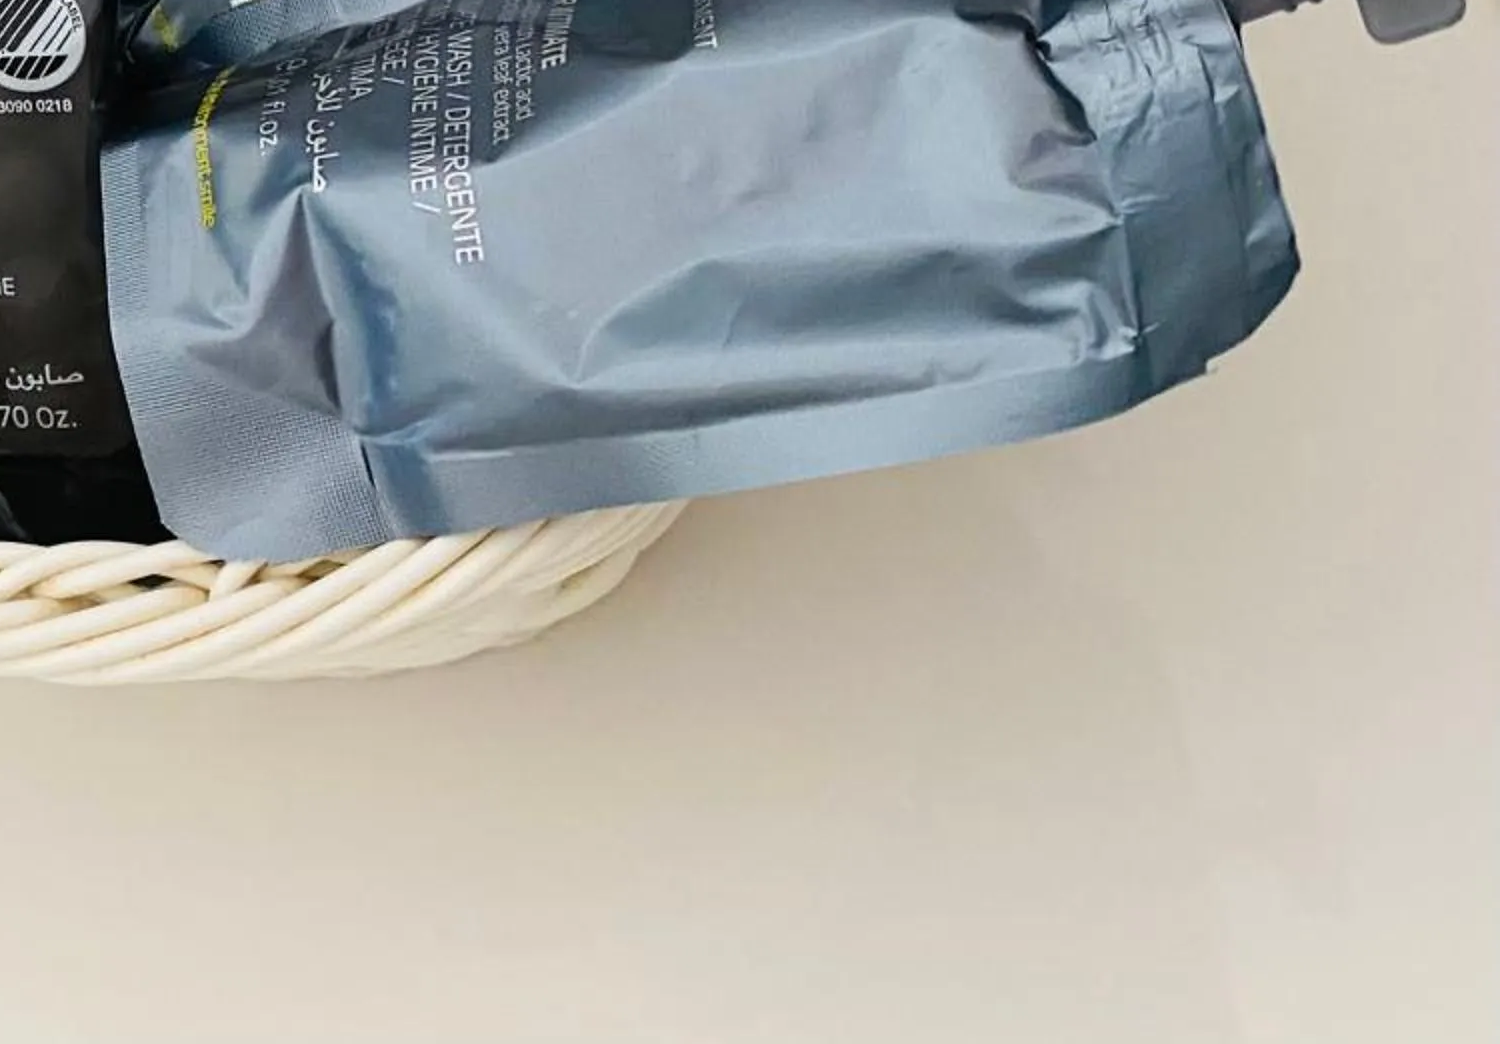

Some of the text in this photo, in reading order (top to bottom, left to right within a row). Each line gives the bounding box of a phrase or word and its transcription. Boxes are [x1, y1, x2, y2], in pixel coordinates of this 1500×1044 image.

[446, 26, 473, 87] WASH
[35, 98, 73, 113] 0218
[305, 118, 341, 194] صابون
[409, 117, 437, 194] INTIME
[412, 201, 441, 214] /
[442, 105, 486, 266] DETERGENTE
[5, 363, 85, 392] صابون
[36, 406, 78, 429] Oz.
